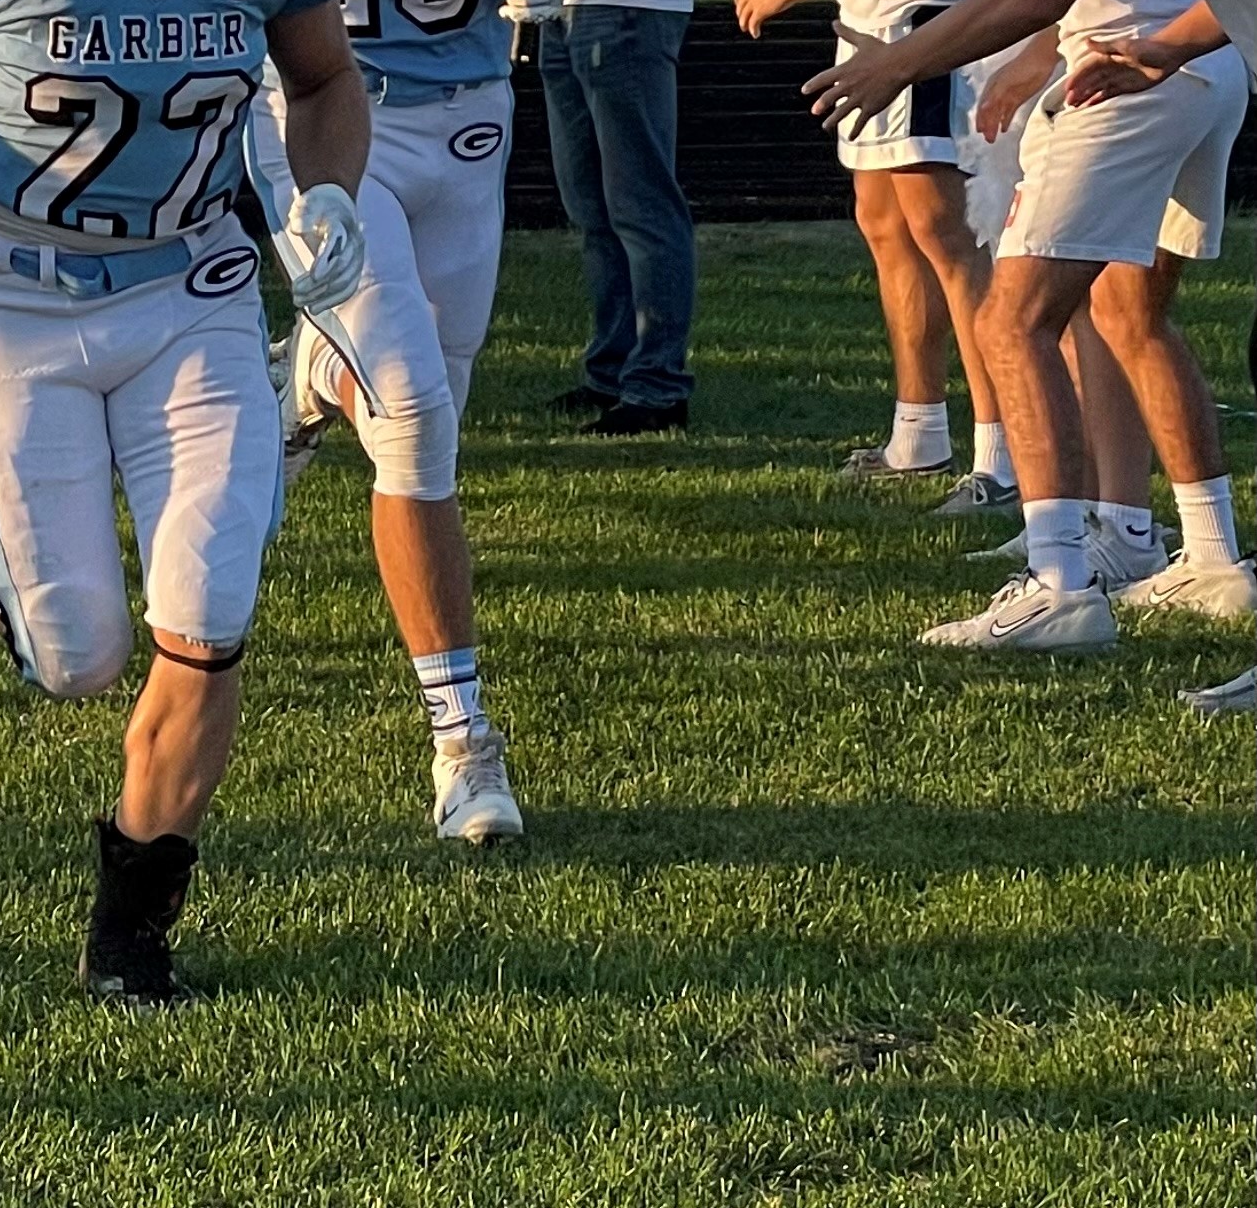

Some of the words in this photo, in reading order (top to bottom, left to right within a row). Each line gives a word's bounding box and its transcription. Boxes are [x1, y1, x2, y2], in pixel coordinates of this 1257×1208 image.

[47, 11, 249, 64] GARBER
[13, 69, 258, 240] 22
[449, 122, 503, 162] G
[185, 246, 259, 298] G
